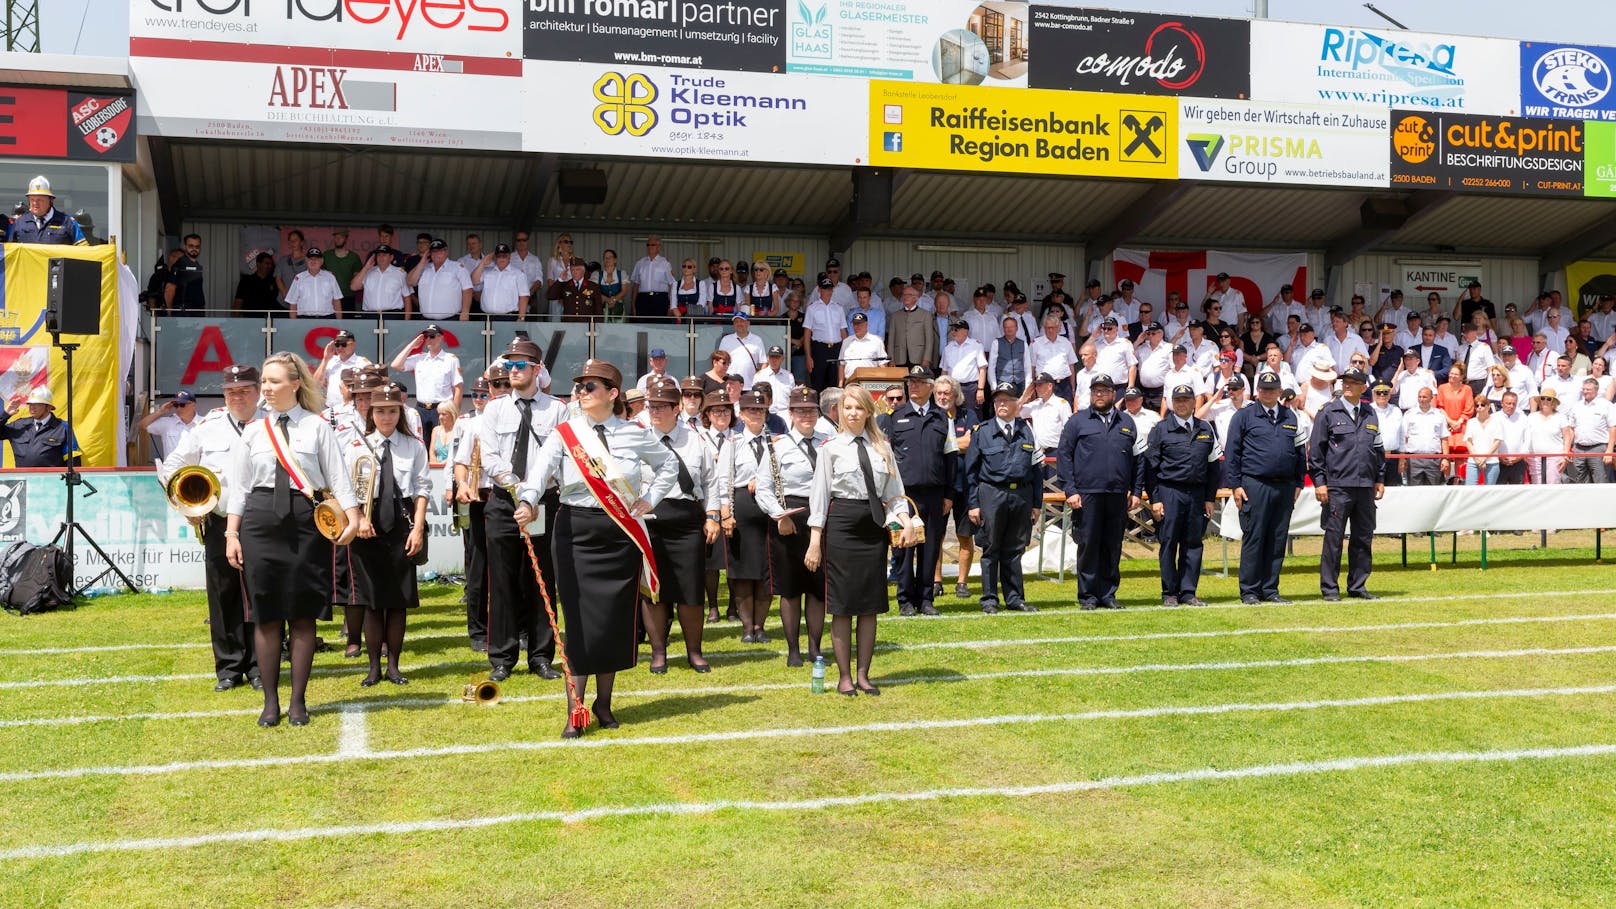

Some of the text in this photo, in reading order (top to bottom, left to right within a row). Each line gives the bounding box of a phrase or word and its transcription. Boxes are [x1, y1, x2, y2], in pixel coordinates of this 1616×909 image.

[856, 1, 906, 11] REGIONALER
[145, 17, 258, 33] www.trendeyes.at
[839, 10, 929, 25] GLASERMEISTER
[1034, 12, 1050, 20] 2542
[1050, 13, 1090, 23] Kottingbrunn,
[1090, 15, 1111, 24] Badner
[1111, 17, 1130, 25] Straße
[529, 19, 779, 47] architektur baumanagement umsetzung facility
[795, 27, 830, 39] GLAS
[1034, 21, 1093, 32] www.bar-comodo.at
[795, 41, 830, 53] HAAS
[1321, 28, 1457, 71] Ripresa
[413, 54, 446, 73] APEX
[614, 50, 703, 66] www.bm-romar.at
[1076, 44, 1186, 86] comodo
[1544, 51, 1602, 74] STEKO
[268, 66, 349, 110] APEX
[670, 74, 726, 88] Trude
[670, 88, 807, 110] Kleemann
[883, 90, 917, 99] Bankstelle
[1318, 89, 1465, 109] www.ripresa.at
[1545, 85, 1599, 105] TRANS
[72, 99, 99, 124] ASC
[79, 97, 128, 136] LEOBERSDORF
[267, 112, 288, 121] DIE
[290, 113, 374, 125] BUCHHALTUNG
[670, 108, 748, 128] Optik
[1184, 106, 1387, 129] Wir geben der Wirtschaft ein Zuhause
[1525, 106, 1550, 117] WIR
[1552, 108, 1599, 120] TRAGEN
[931, 107, 1110, 136] Raiffeisenbank
[669, 131, 725, 141] gegr. 1843
[651, 145, 750, 157] www.optik-kleemann.at
[950, 134, 1110, 163] Region Baden
[1229, 135, 1323, 159] PRISMA
[1400, 145, 1431, 157] print
[1225, 156, 1277, 180] Group
[1447, 154, 1582, 171] BESCHRIFTUNGSDESIGN
[1284, 169, 1385, 181] www.betriebsbauland.at
[1596, 164, 1616, 178] GÄ
[1393, 175, 1409, 183] 2500
[1411, 176, 1436, 184] BADEN
[1463, 178, 1483, 187] 02252
[1407, 271, 1456, 283] KANTINE
[86, 549, 136, 566] Marke
[142, 548, 164, 564] für
[98, 572, 160, 588] Wasser
